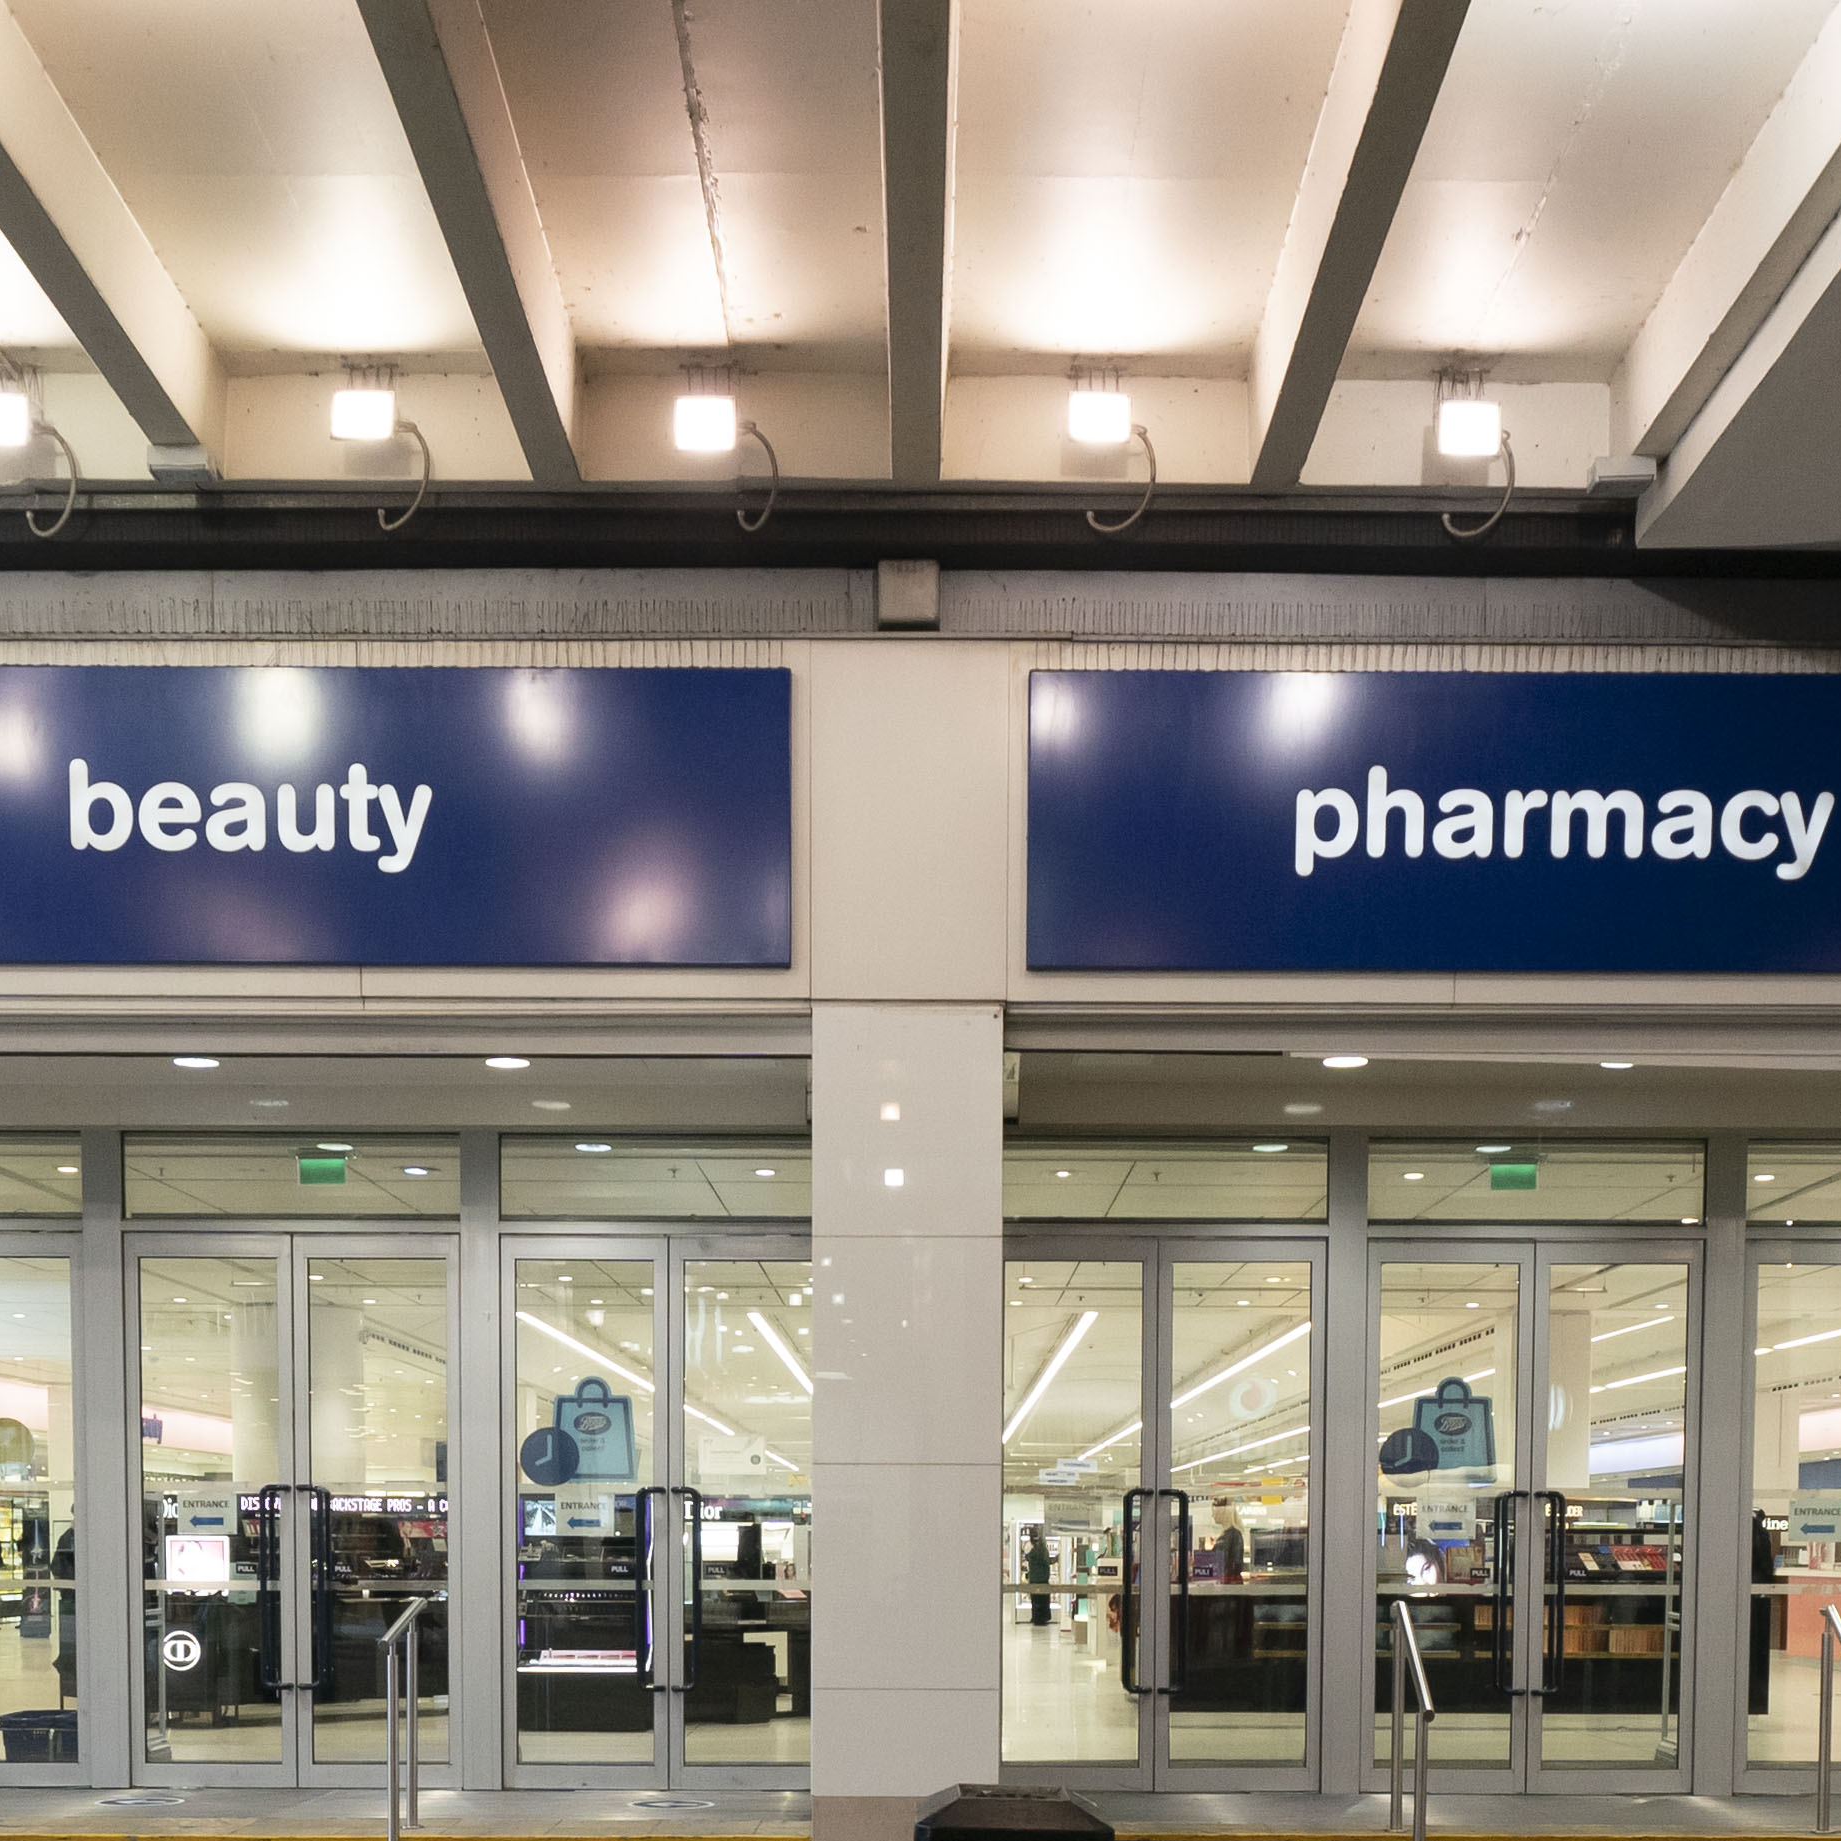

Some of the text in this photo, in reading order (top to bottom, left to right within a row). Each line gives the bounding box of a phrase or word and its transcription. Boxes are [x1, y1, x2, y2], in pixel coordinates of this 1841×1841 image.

[69, 758, 433, 873] beauty
[1295, 765, 1835, 880] pharmacy
[182, 1500, 229, 1508] ENTRANCE
[387, 1498, 412, 1512] PROS
[1421, 1505, 1468, 1513] ENTRANCE
[1794, 1508, 1841, 1516] ENTRANCE
